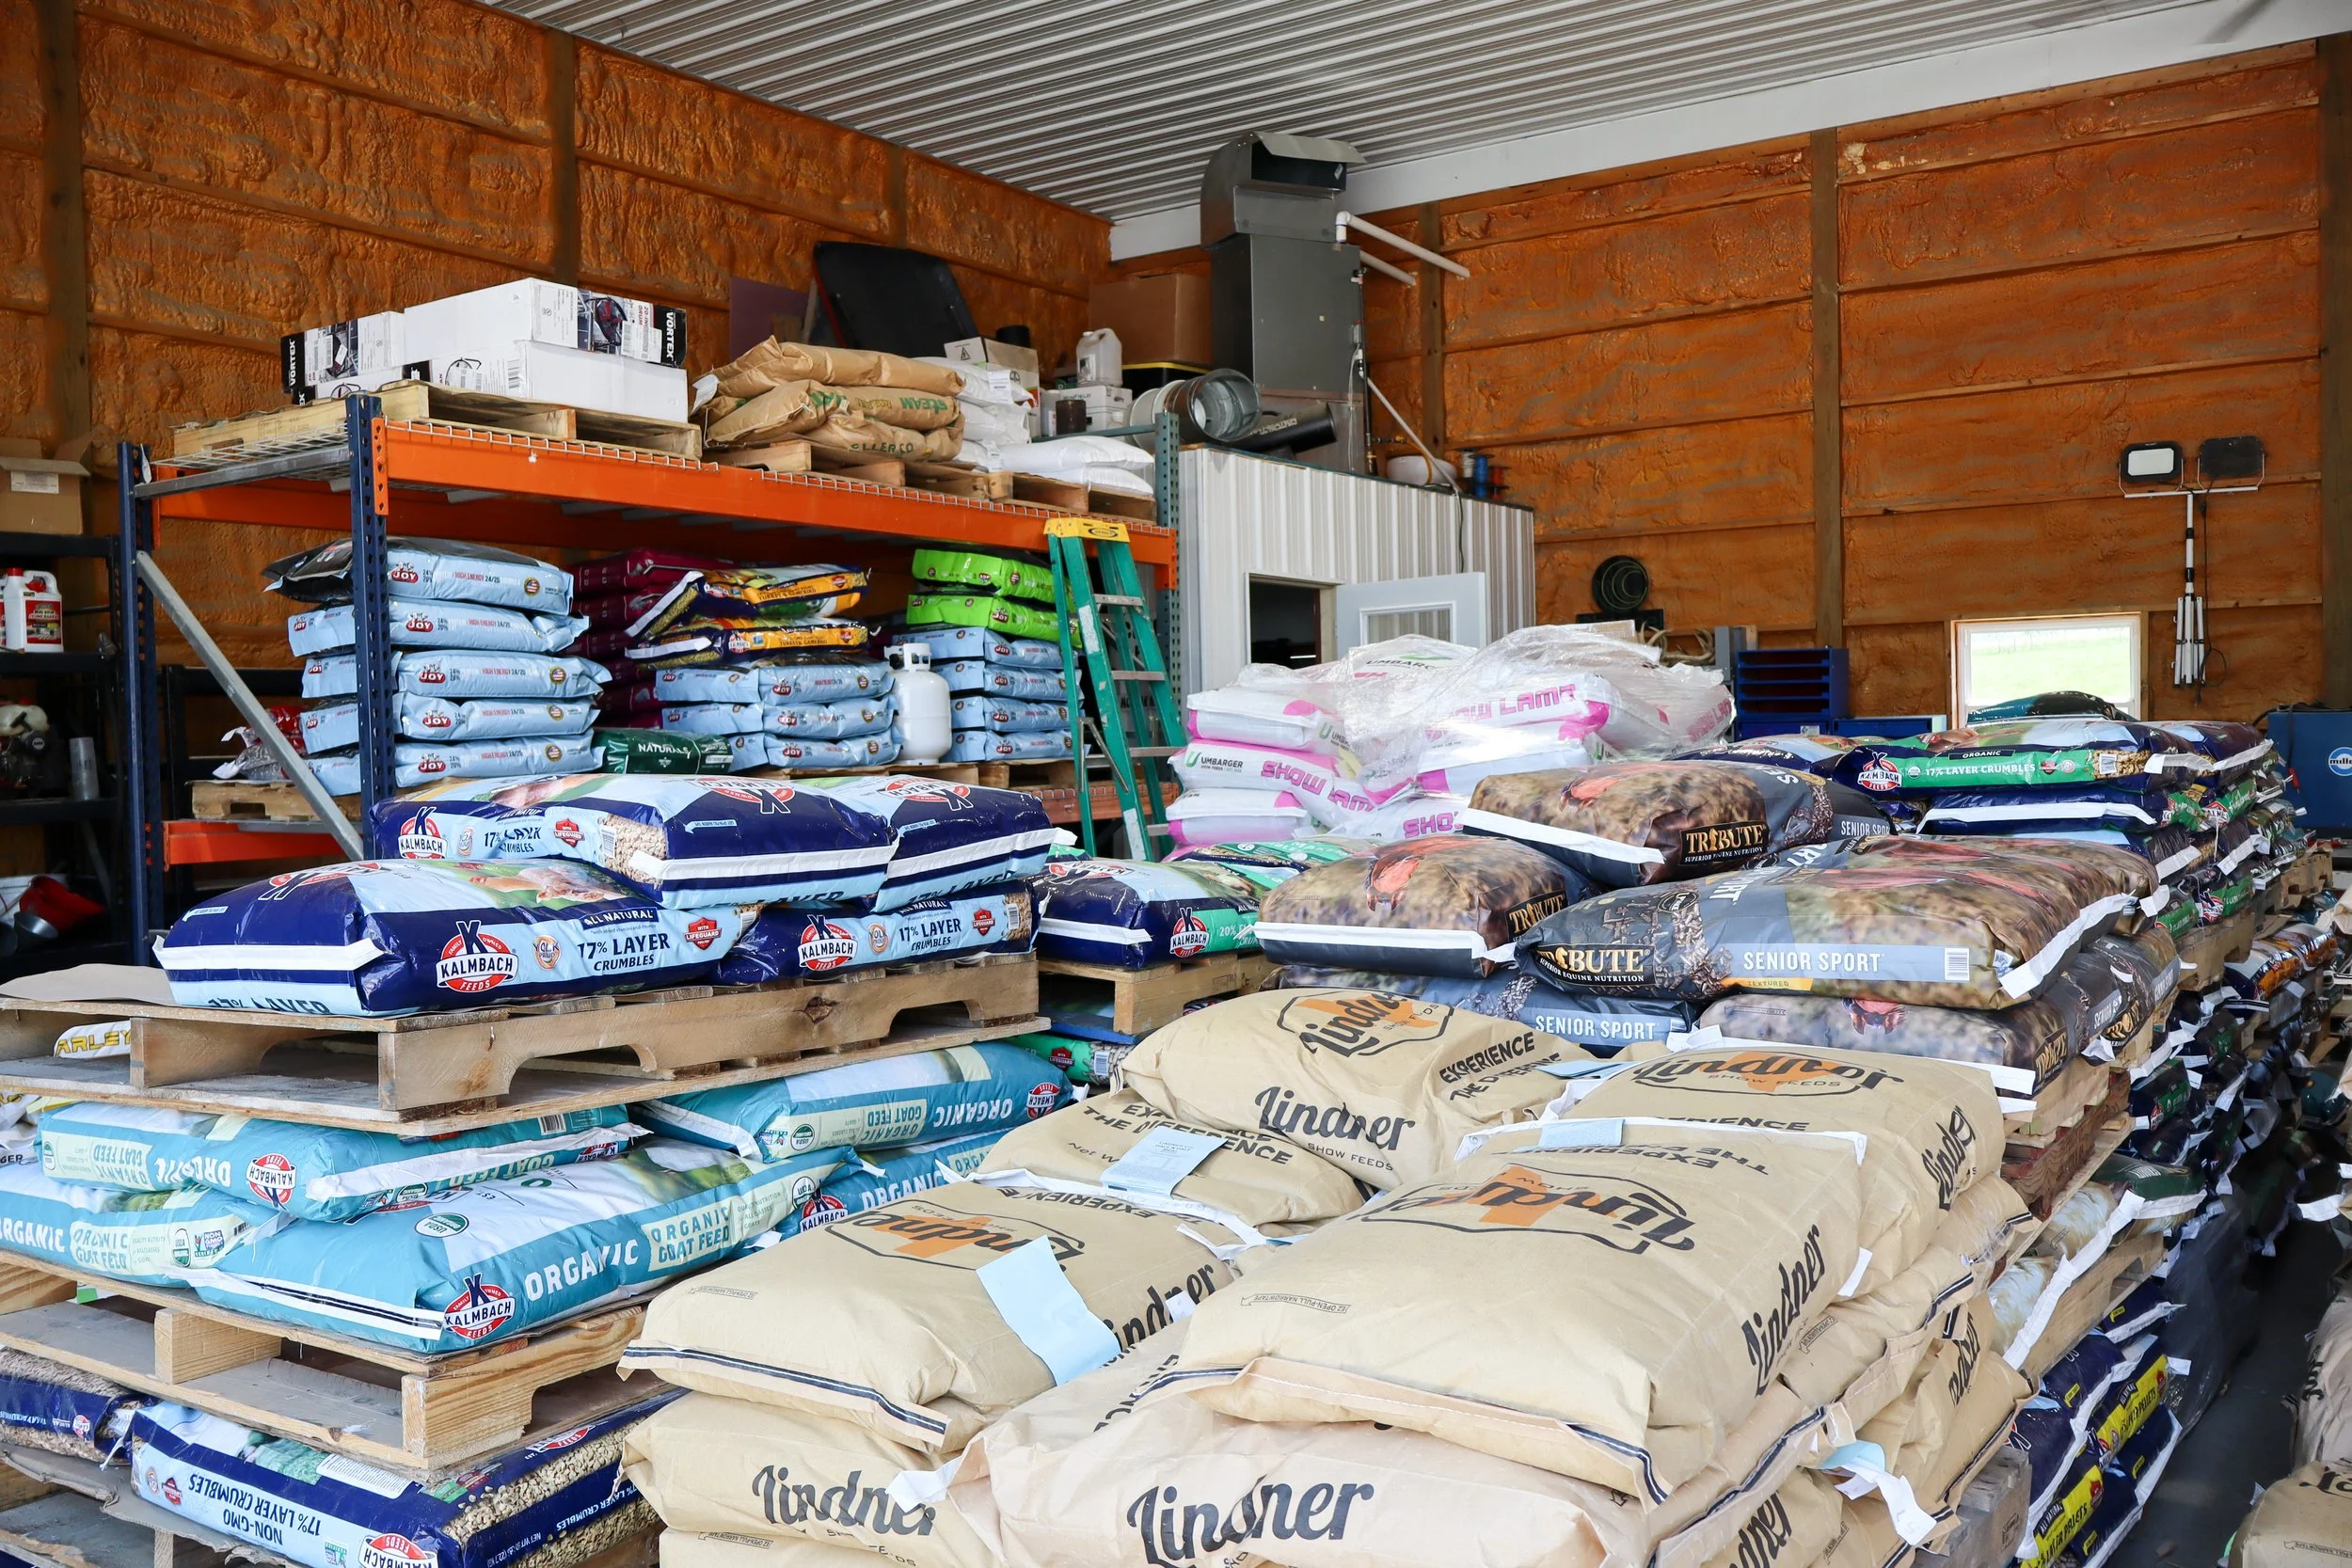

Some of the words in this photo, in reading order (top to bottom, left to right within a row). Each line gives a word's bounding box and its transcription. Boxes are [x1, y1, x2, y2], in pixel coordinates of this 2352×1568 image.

[993, 612, 1008, 621] JOY
[773, 686, 791, 694] JOY
[425, 716, 449, 725] JOY
[668, 713, 679, 721] JOY
[638, 742, 691, 756] NATURALS
[1962, 751, 2001, 759] ORGANIC
[420, 762, 444, 770] JOY
[1200, 756, 1243, 768] UMBARGER
[1925, 768, 1945, 776] 17%
[1946, 765, 1979, 774] LAYER
[1981, 763, 2036, 774] CRUMBLES
[1261, 760, 1327, 796] SHOW
[1859, 771, 1900, 782] KALMBACH
[554, 832, 584, 840] LIFEGUARD
[1841, 821, 1871, 835] SENIOR
[400, 839, 442, 853] KALMBACH
[485, 832, 501, 847] 17%
[1685, 852, 1711, 863] SUPERIOR
[1734, 847, 1763, 856] NUTRITION
[914, 900, 947, 909] NATURAL
[583, 913, 603, 926] ALL
[603, 910, 653, 920] NATURAL
[686, 930, 721, 940] LIFEGUARD
[898, 926, 919, 942] 17%
[921, 918, 961, 937] LAYER
[1219, 926, 1237, 938] 20%
[448, 940, 462, 956] FAMILY
[483, 938, 502, 951] OWNED
[577, 942, 608, 959] 17%
[613, 933, 671, 956] LAYER
[911, 936, 951, 951] CRUMBLES
[1172, 933, 1207, 948] KALMBACH
[802, 942, 853, 958] KALMBACH
[440, 956, 513, 978] KALMBACH
[593, 955, 655, 972] CRUMBLES
[1540, 958, 1562, 975] SUPERIOR
[1563, 971, 1592, 981] EQUINE
[1743, 951, 1812, 971] SENIOR
[1818, 951, 1881, 972] SPORT
[460, 979, 491, 991] FEEDS
[1535, 1015, 1595, 1037] SENIOR
[1600, 1017, 1657, 1040] SPORT
[1440, 1032, 1534, 1084] EXPERIENCE
[1632, 1054, 1905, 1090] Lindner
[1708, 1073, 1767, 1085] SHOW
[1775, 1079, 1842, 1087] FEEDS
[1450, 1083, 1489, 1101] THE
[867, 1111, 891, 1127] FEED
[895, 1104, 923, 1122] GOAT
[933, 1099, 1014, 1128] ORGANIC
[1083, 1106, 1132, 1130] THE
[1254, 1086, 1416, 1152] Lindner
[860, 1122, 918, 1150] ORGANIC
[94, 1145, 116, 1162] FEED
[1069, 1142, 1098, 1156] Net
[1308, 1142, 1345, 1160] SHOW
[1351, 1153, 1394, 1172] FEEDS
[265, 1155, 285, 1166] FEEDS
[1695, 1148, 1769, 1175] THE
[248, 1167, 294, 1185] KALMBACH
[423, 1222, 447, 1234] USDA
[433, 1215, 463, 1228] ORGANIC
[651, 1204, 730, 1242] ORGANIC
[803, 1212, 845, 1231] KALMBACH
[659, 1236, 694, 1262] GOAT
[698, 1226, 730, 1252] FEED
[524, 1238, 640, 1301] ORGANIC
[453, 1294, 469, 1310] FAMILY
[484, 1288, 502, 1296] OWNED
[1300, 1298, 1336, 1311] OPEN-PULL
[445, 1302, 512, 1326] KALMBACH
[1103, 1264, 1215, 1353] inder
[1740, 1225, 1826, 1399] Lindner
[467, 1324, 493, 1338] FEEDS
[2119, 1393, 2127, 1405] ALL
[2123, 1382, 2137, 1399] NATURAL
[2138, 1387, 2156, 1416] PELLETS
[557, 1433, 581, 1447] FEEDS
[188, 1473, 250, 1507] CRUMBLES
[752, 1465, 937, 1537] Lindner
[254, 1503, 294, 1527] LAYER
[296, 1511, 321, 1537] 17%
[556, 1504, 598, 1531] CRUMBLES
[1127, 1474, 1374, 1568] Lindner
[2040, 1523, 2049, 1534] ALL
[2047, 1503, 2063, 1524] NATURAL
[2068, 1502, 2088, 1533] PELLETS
[223, 1508, 283, 1545] NON-GMO
[385, 1535, 411, 1550] FEEDS
[530, 1532, 541, 1543] NET
